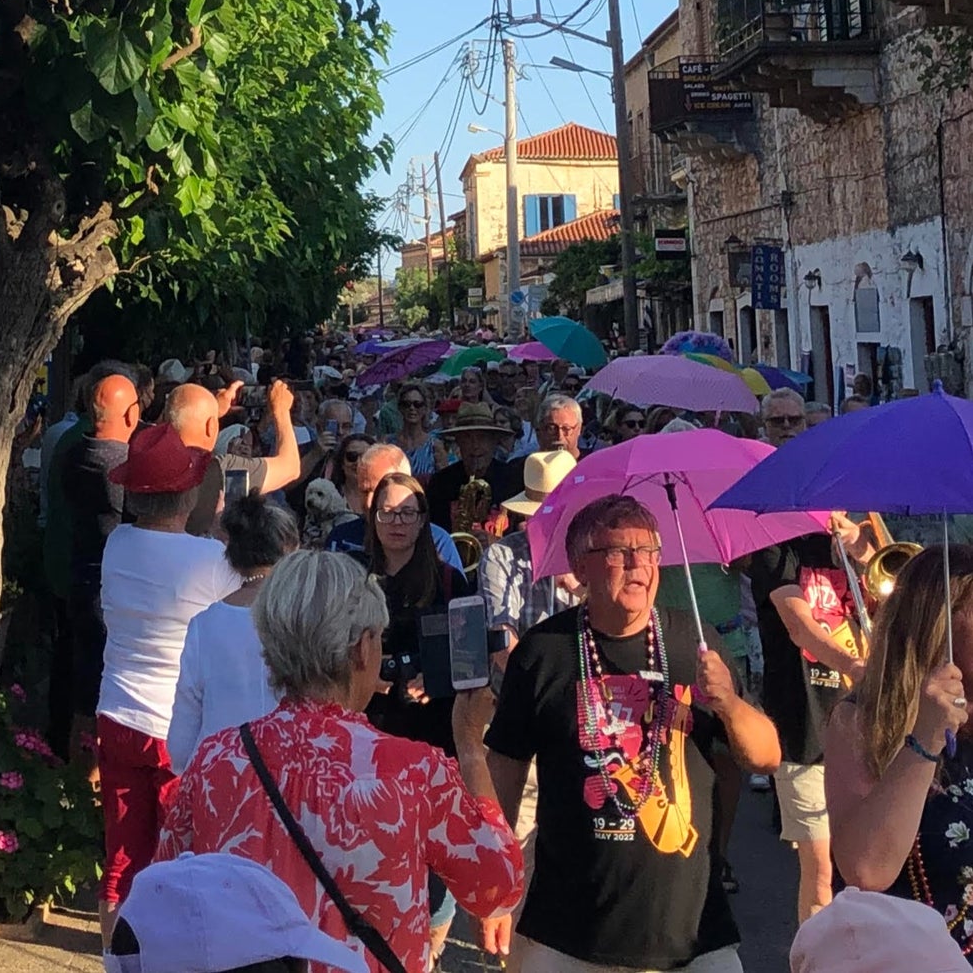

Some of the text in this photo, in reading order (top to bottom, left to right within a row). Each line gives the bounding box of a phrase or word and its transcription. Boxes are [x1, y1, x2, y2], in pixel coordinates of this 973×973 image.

[711, 92, 751, 101] SPAGETTI
[769, 253, 779, 304] ROOMS
[810, 668, 820, 678] 19
[829, 670, 840, 680] 29
[593, 817, 605, 829] 19
[619, 818, 635, 830] 29
